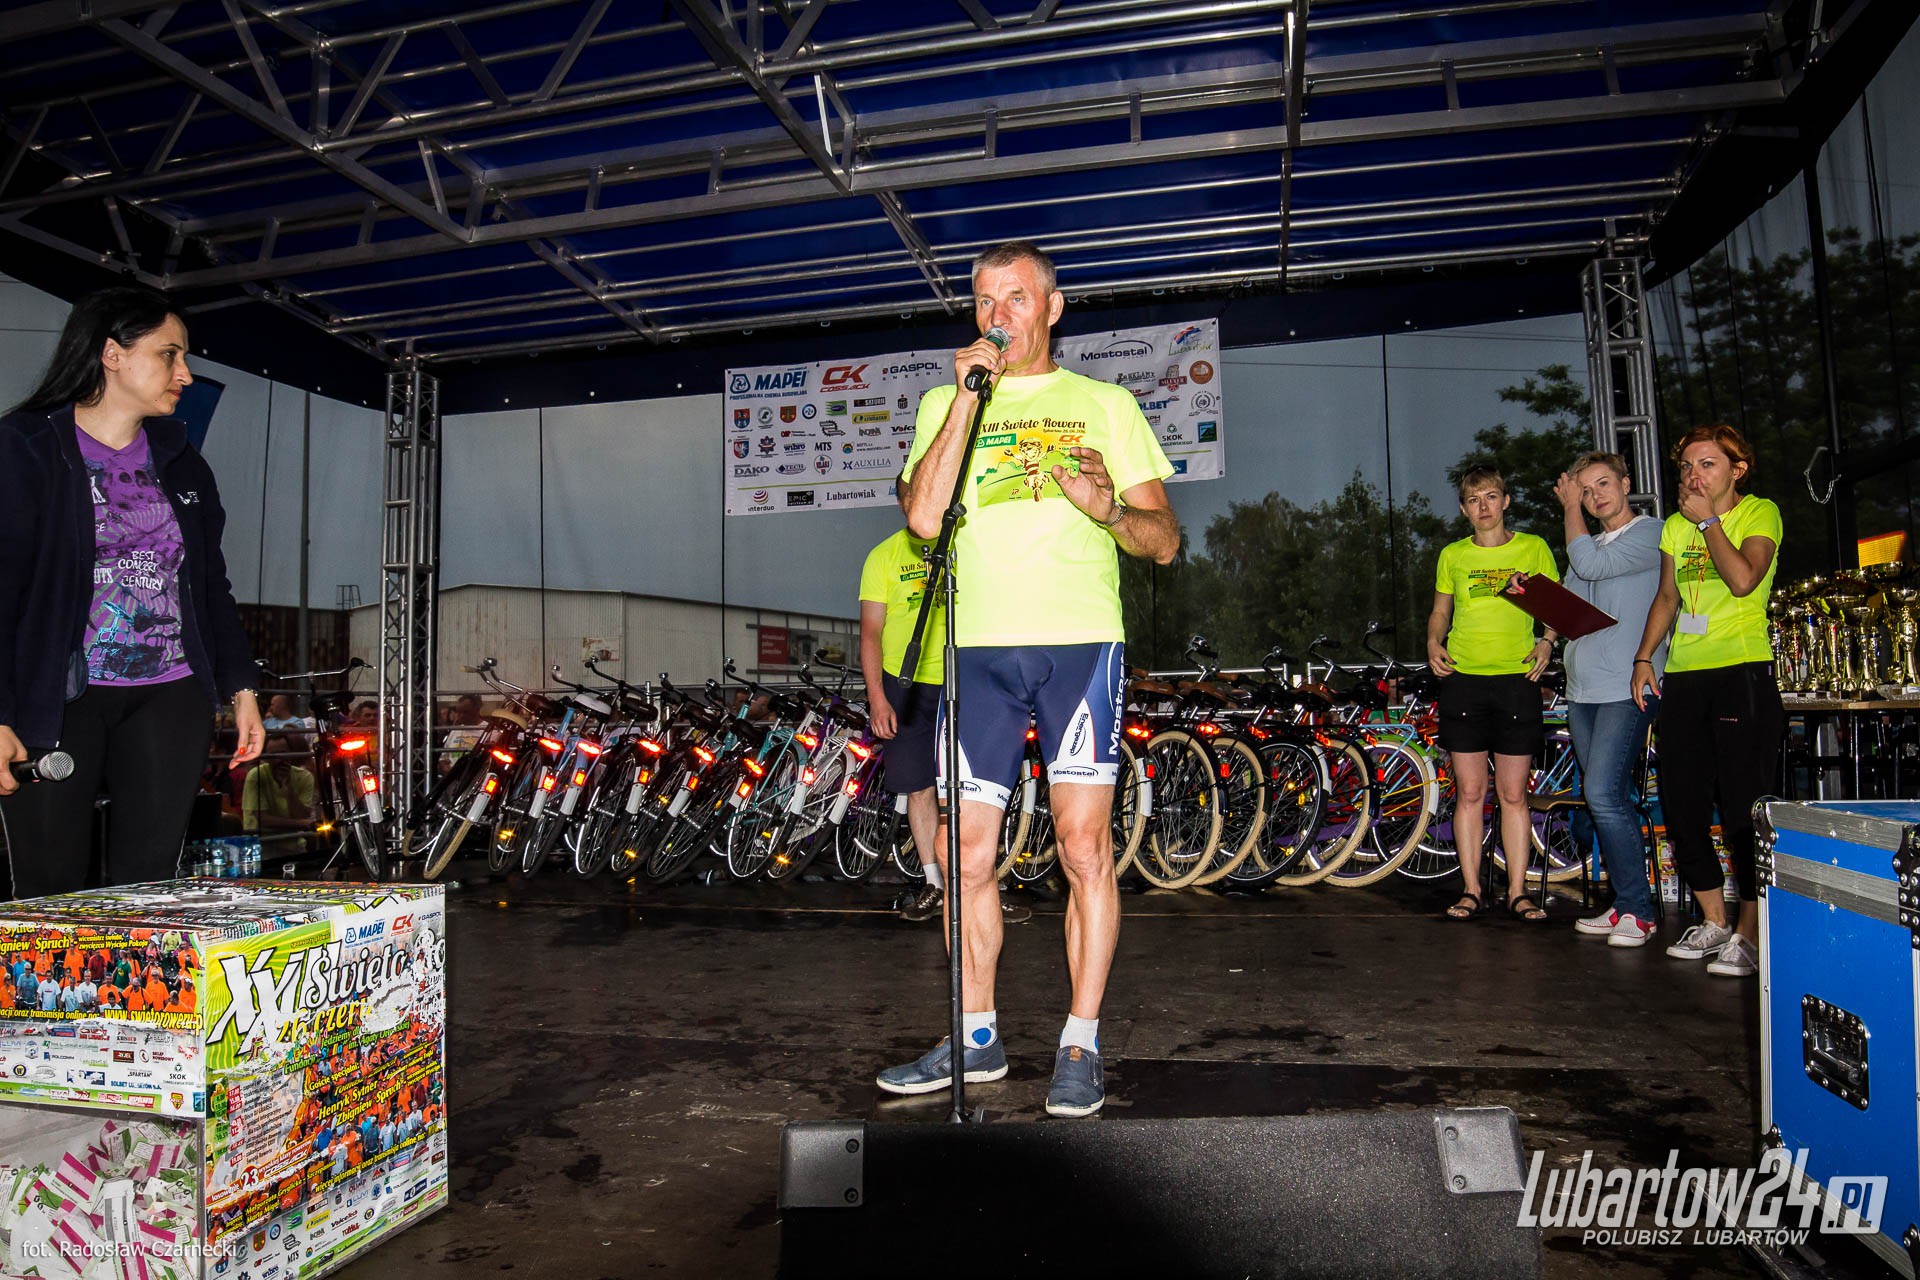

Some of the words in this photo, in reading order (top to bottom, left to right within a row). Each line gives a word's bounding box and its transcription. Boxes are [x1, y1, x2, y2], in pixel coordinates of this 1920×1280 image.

[1081, 347, 1148, 362] Mostostal
[890, 362, 943, 374] GASPOL
[754, 371, 807, 390] MAPEI
[1139, 400, 1168, 410] OLBET
[1043, 417, 1086, 429] Roweru
[815, 442, 832, 451] MTS
[985, 436, 1012, 445] MAPEI
[854, 458, 891, 467] AUXILIA
[735, 466, 770, 475] DAKO
[826, 489, 876, 501] Lubartowiak
[131, 551, 155, 560] BEST
[121, 575, 163, 590] CENTURY
[1053, 768, 1095, 777] Mostostal
[358, 921, 385, 940] MAPEI
[35, 936, 69, 953] Spruch
[30, 1008, 64, 1020] transmisja
[318, 1094, 350, 1121] Henryk
[336, 1099, 372, 1127] Zbigniew
[376, 1079, 401, 1103] Spruch
[241, 1169, 259, 1191] 23
